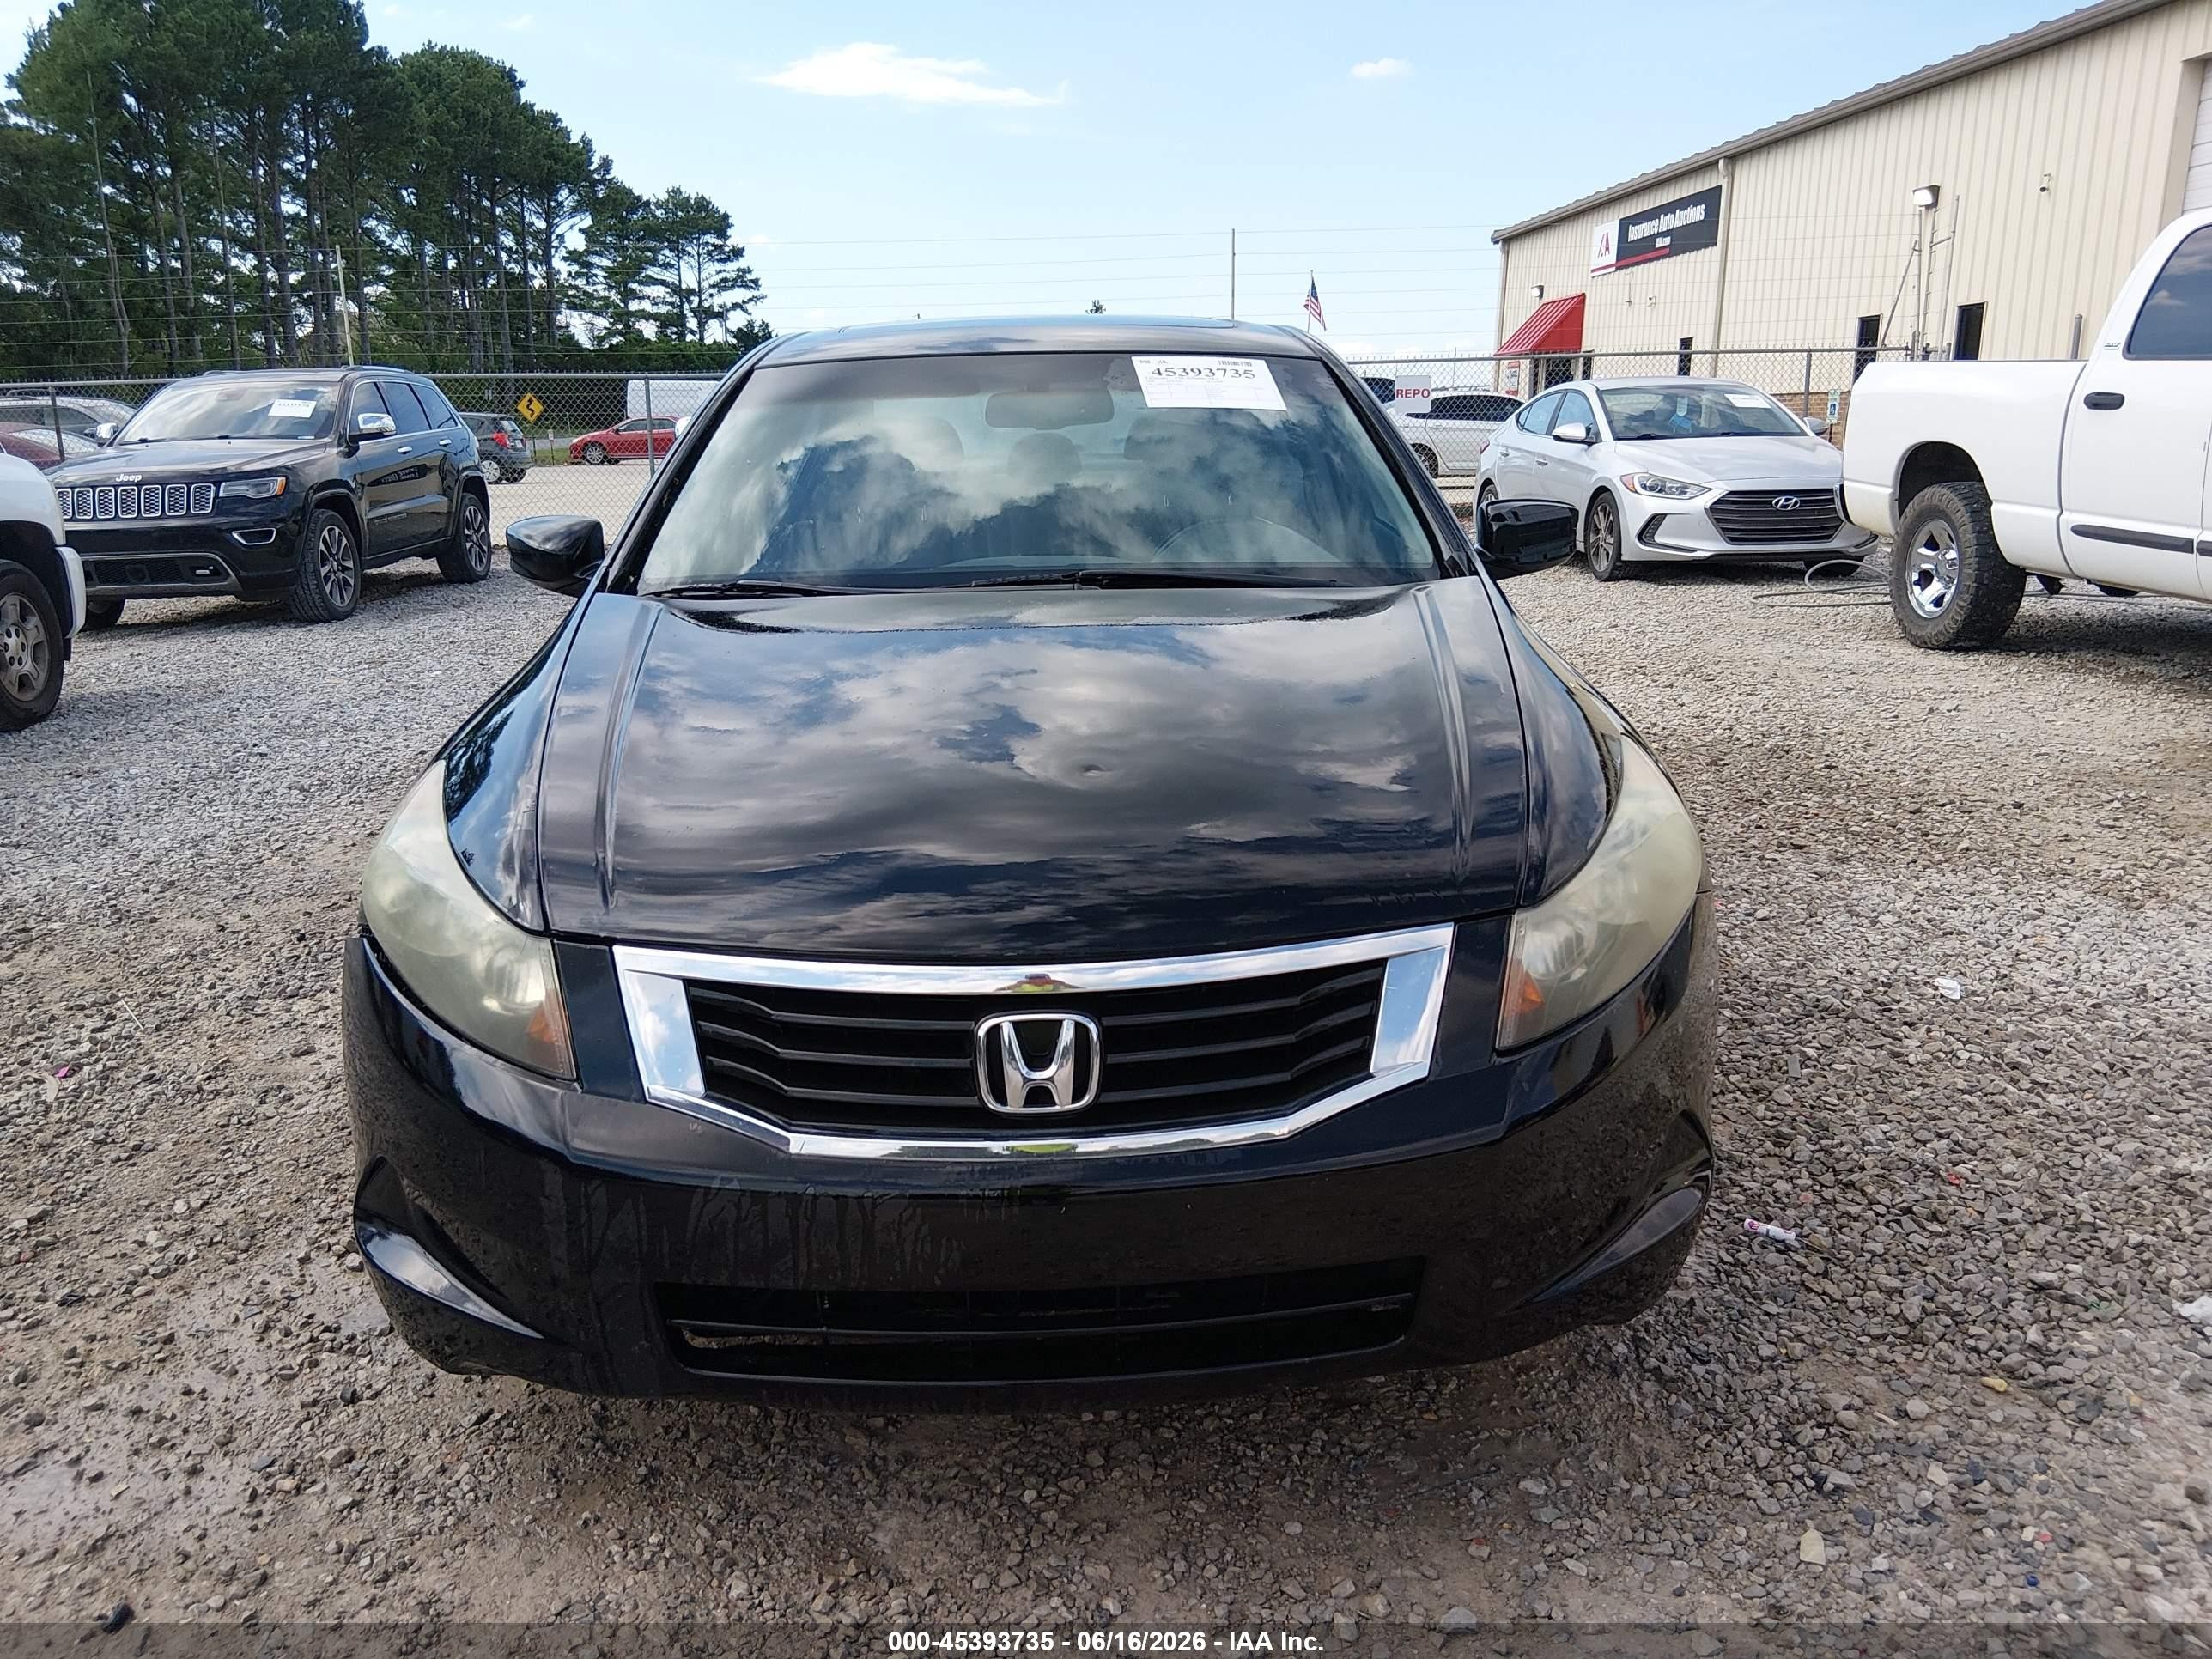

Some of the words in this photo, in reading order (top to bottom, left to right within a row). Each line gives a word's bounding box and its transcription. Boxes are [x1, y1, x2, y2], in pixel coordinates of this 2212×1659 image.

[1627, 219, 1659, 243] Insurance
[1659, 212, 1674, 233] Auto
[1674, 204, 1706, 228] Auctions
[1151, 367, 1256, 380] 45393735
[1395, 388, 1431, 398] REPO
[115, 473, 143, 483] Jeep
